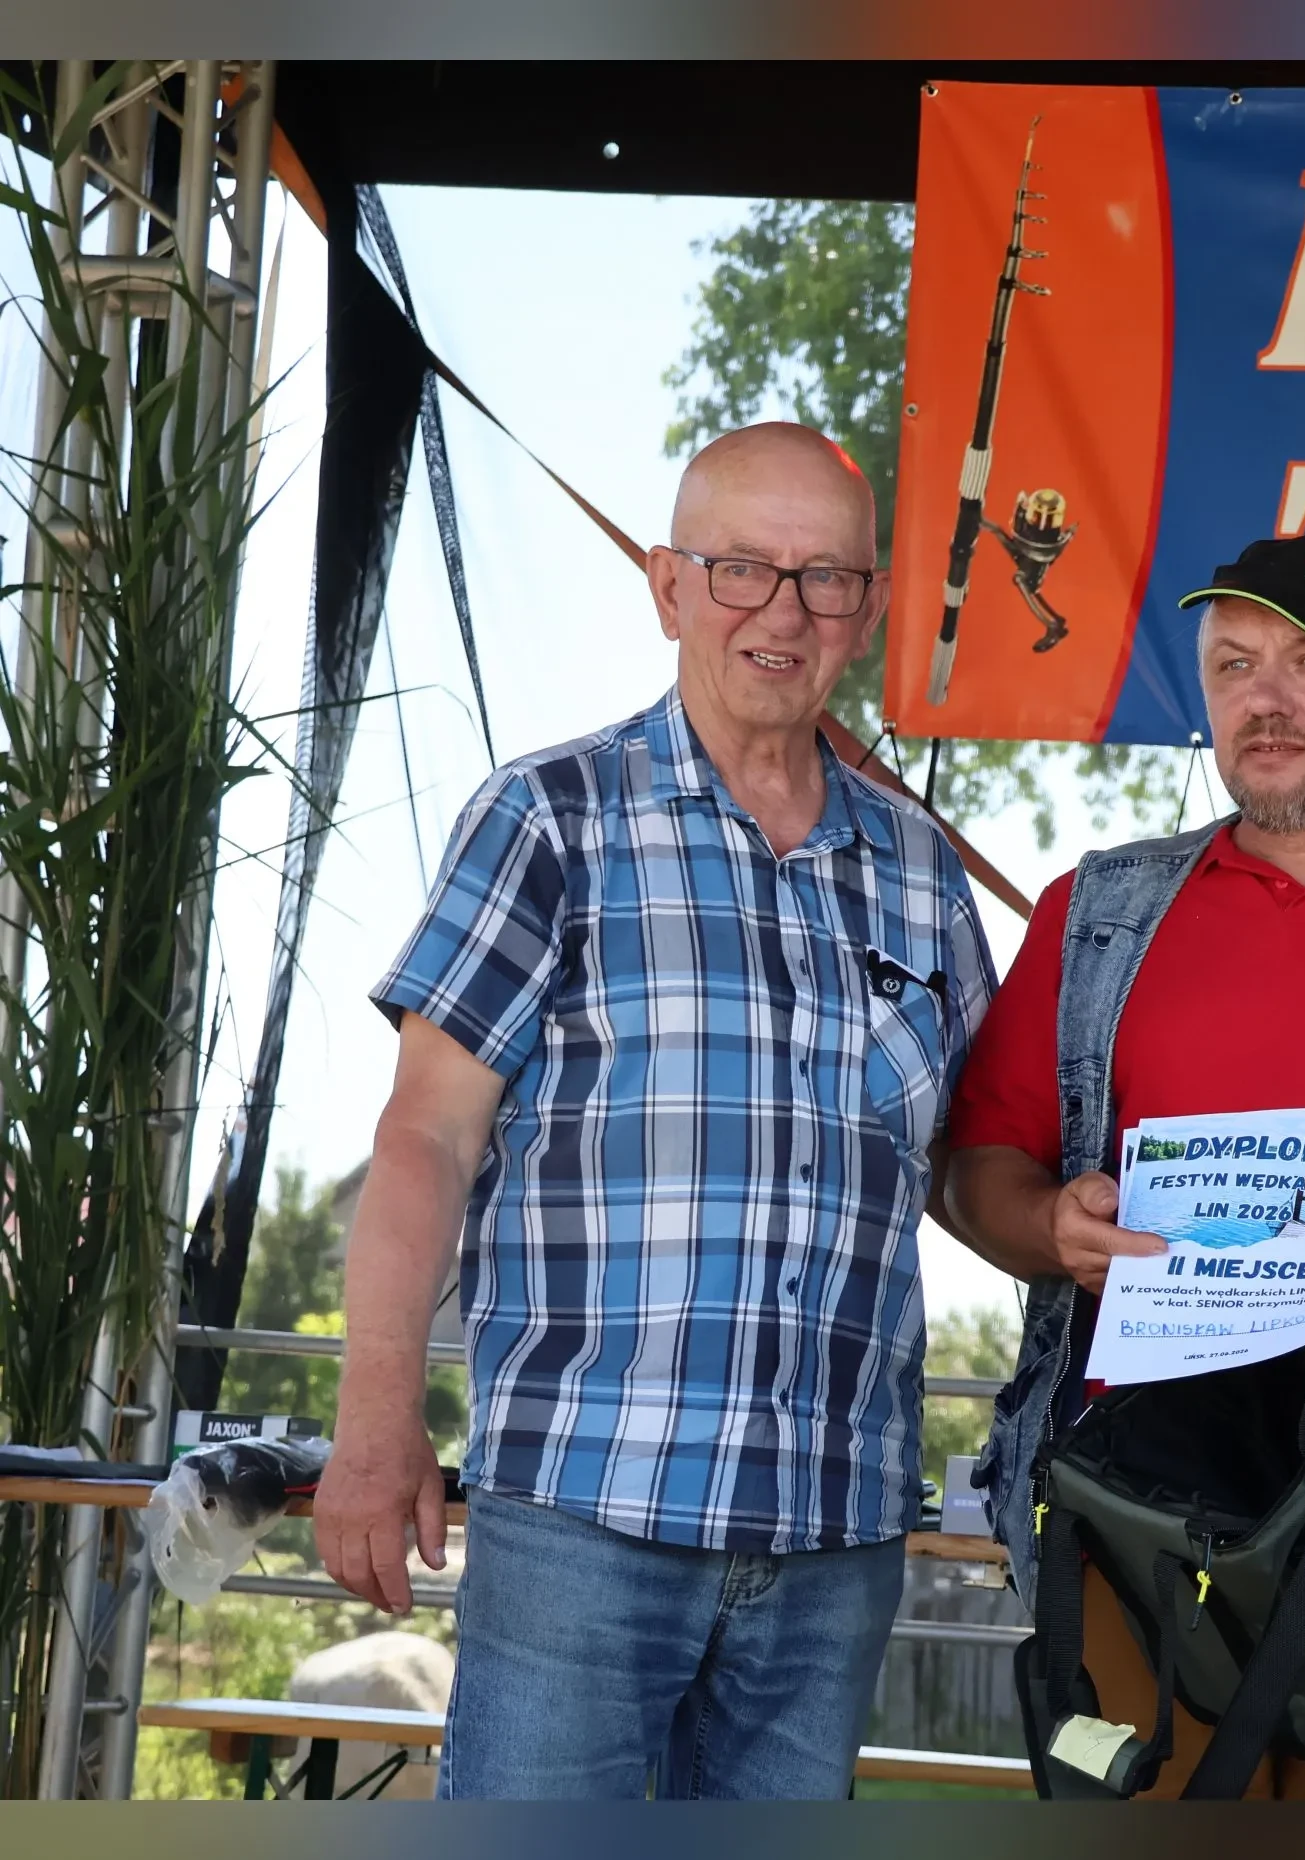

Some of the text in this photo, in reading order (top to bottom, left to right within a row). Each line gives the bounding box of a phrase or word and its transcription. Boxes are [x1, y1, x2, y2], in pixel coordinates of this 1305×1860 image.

[1149, 1173, 1228, 1190] FESTYN
[1194, 1202, 1293, 1222] LIN 2026
[1167, 1255, 1186, 1276] II
[1120, 1285, 1134, 1293] W
[1137, 1285, 1202, 1295] zawodach
[1205, 1287, 1286, 1299] wędkarskich
[1153, 1299, 1164, 1307] w
[1168, 1297, 1192, 1307] kat.
[1196, 1299, 1244, 1308] SENIOR
[205, 1421, 251, 1438] JAXON
